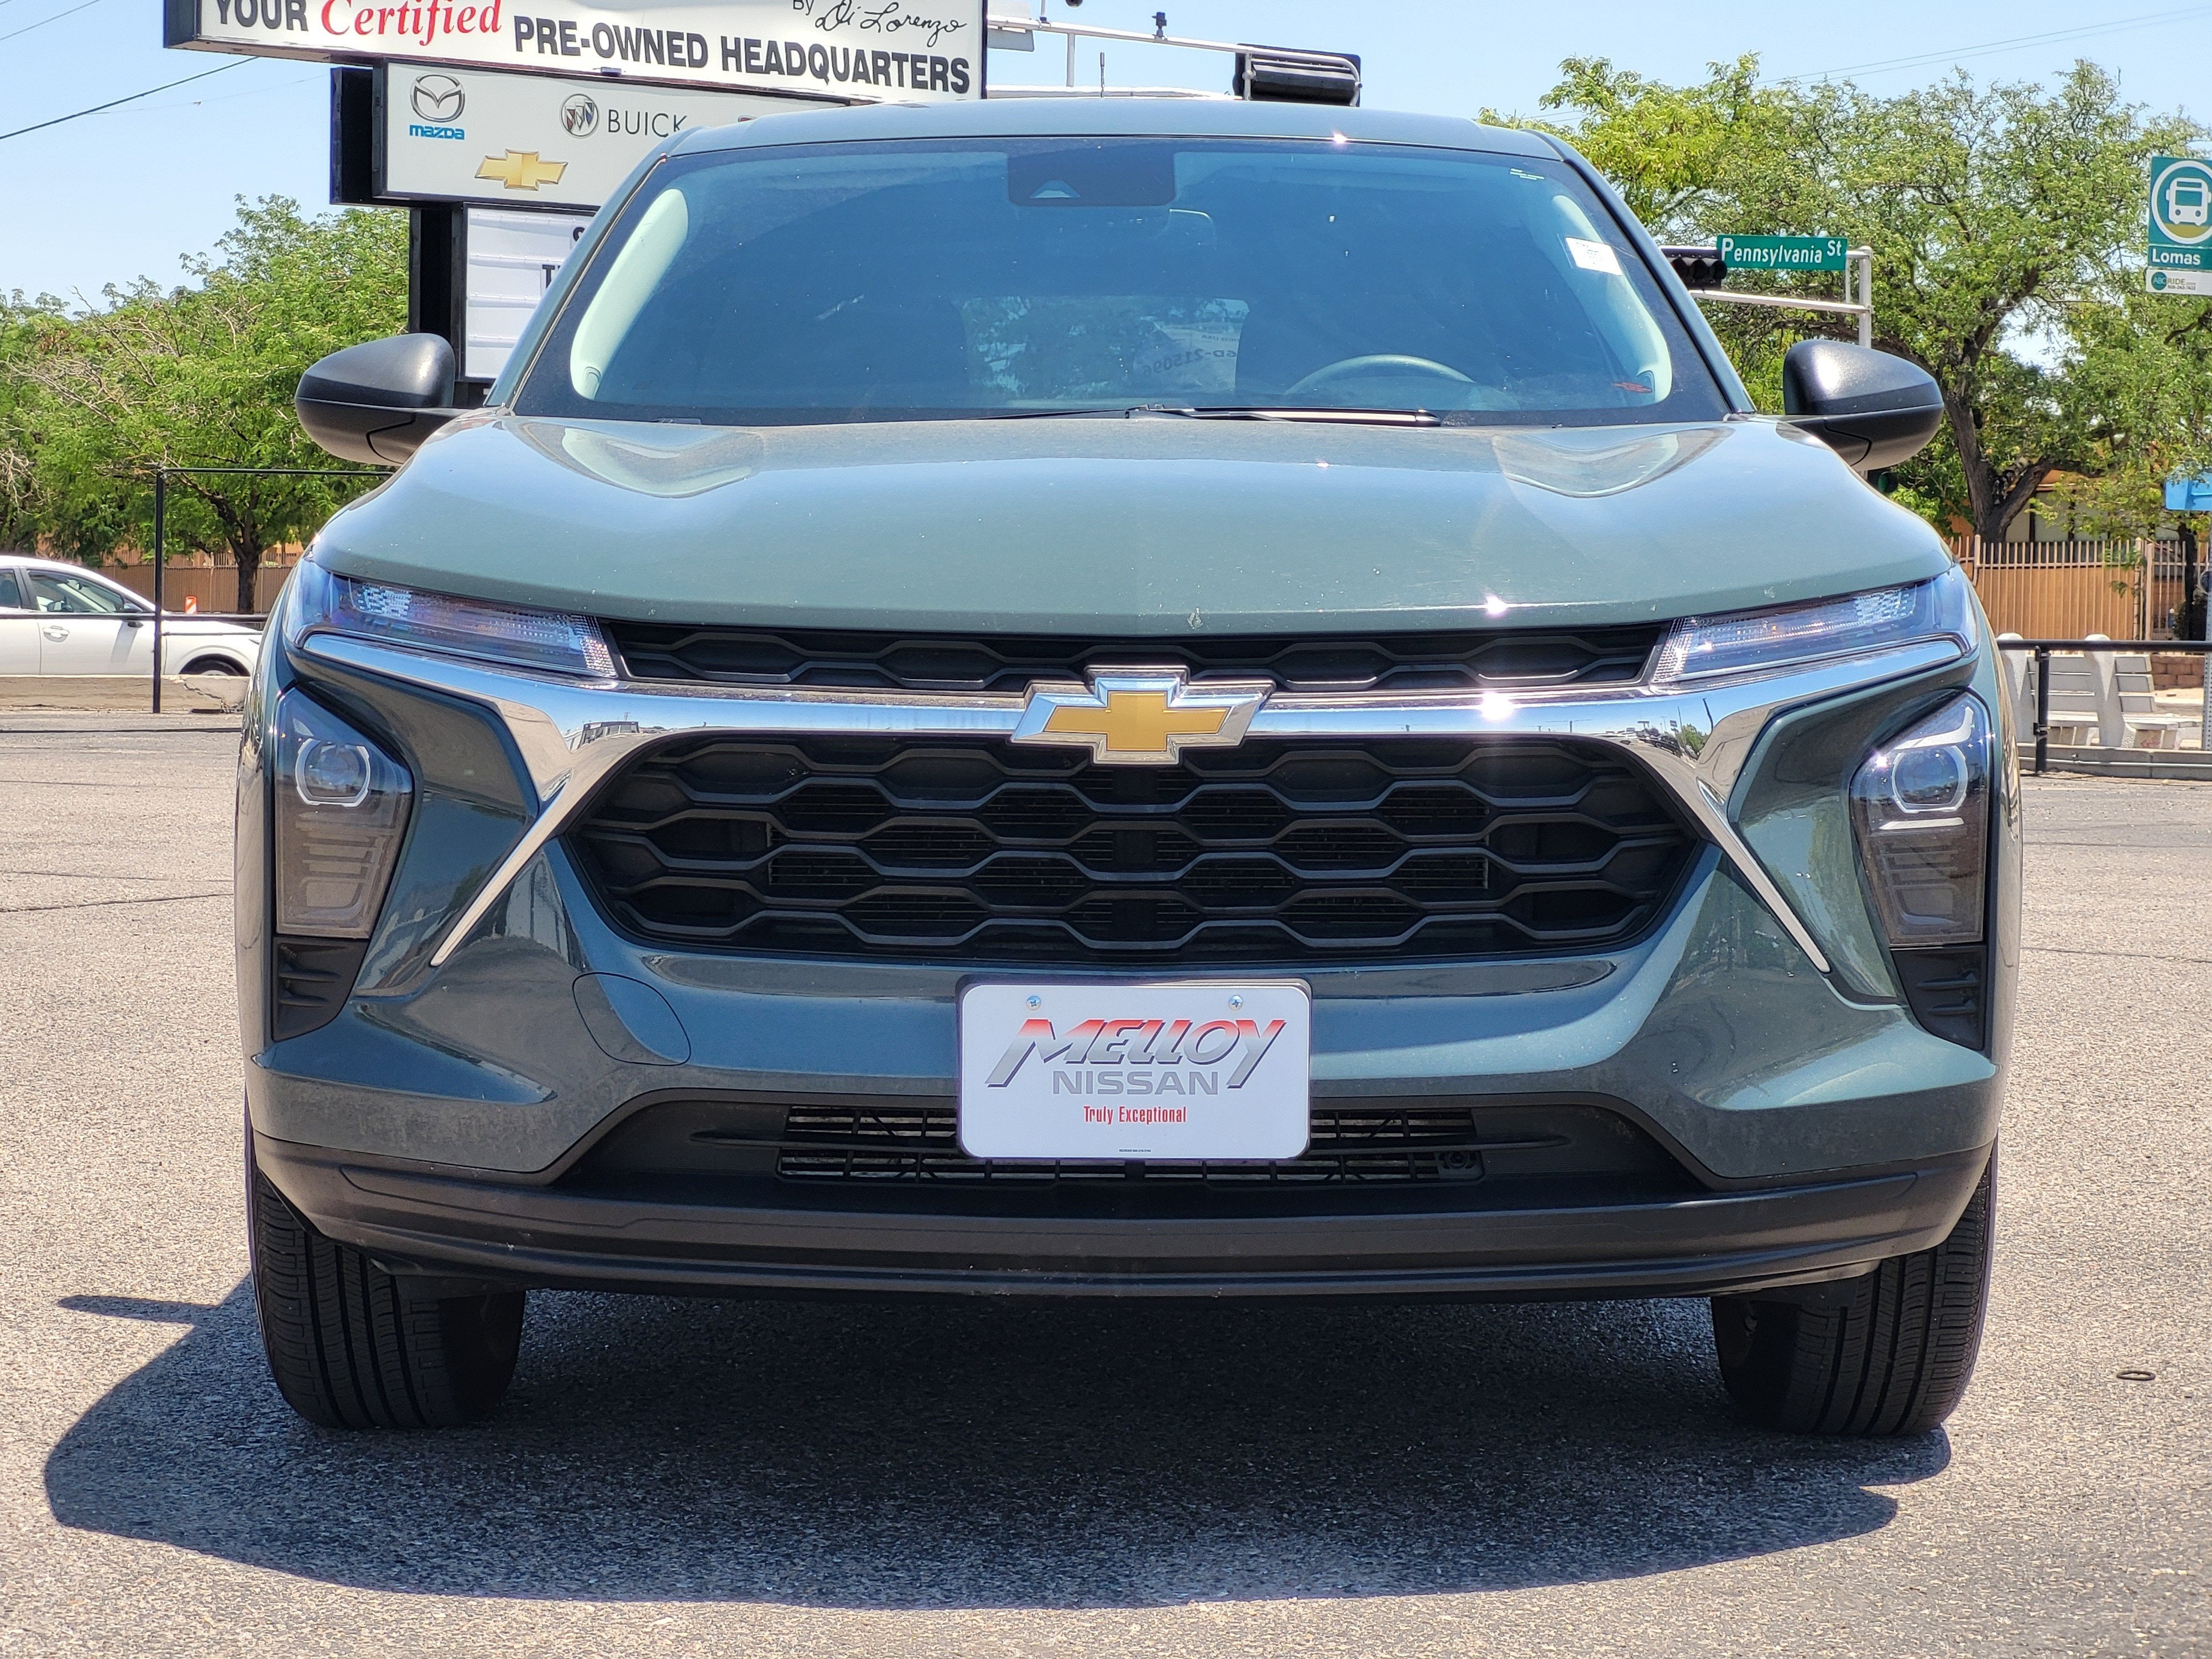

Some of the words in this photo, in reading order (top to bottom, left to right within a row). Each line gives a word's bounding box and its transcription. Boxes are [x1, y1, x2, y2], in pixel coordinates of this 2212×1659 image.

[860, 2, 967, 47] Lorenzo
[217, 0, 309, 32] YOUR
[321, 0, 502, 46] Certified
[514, 15, 708, 67] PRE-OWNED
[721, 36, 970, 94] HEADQUARTERS
[608, 109, 687, 138] BUICK
[1721, 238, 1823, 267] Pennsylvania
[1827, 240, 1841, 257] St
[2152, 249, 2200, 265] Lomas
[984, 1019, 1287, 1089] MELLOY
[1053, 1071, 1218, 1095] NISSAN
[1083, 1106, 1114, 1125] Truly
[1119, 1106, 1187, 1124] Exceptional
